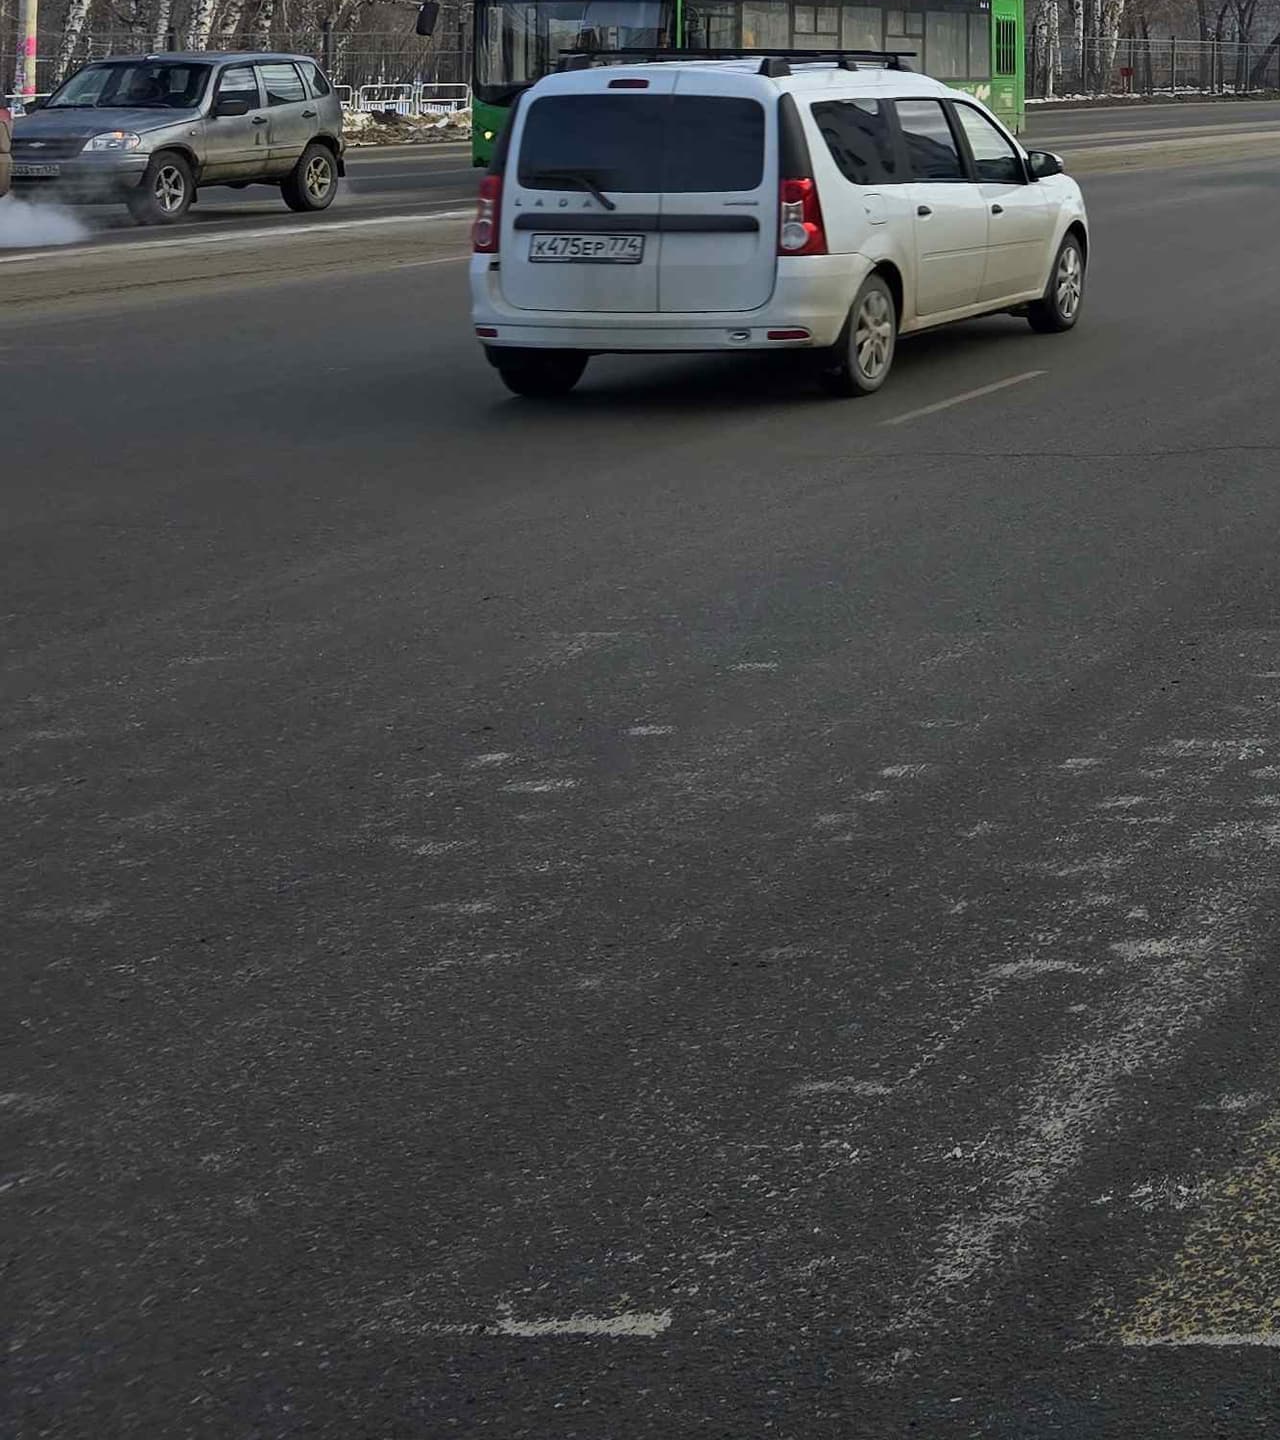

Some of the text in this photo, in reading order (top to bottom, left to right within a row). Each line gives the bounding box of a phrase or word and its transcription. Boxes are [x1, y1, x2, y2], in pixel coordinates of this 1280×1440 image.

[514, 198, 593, 207] LADA
[535, 237, 639, 256] К475ЕР 774
